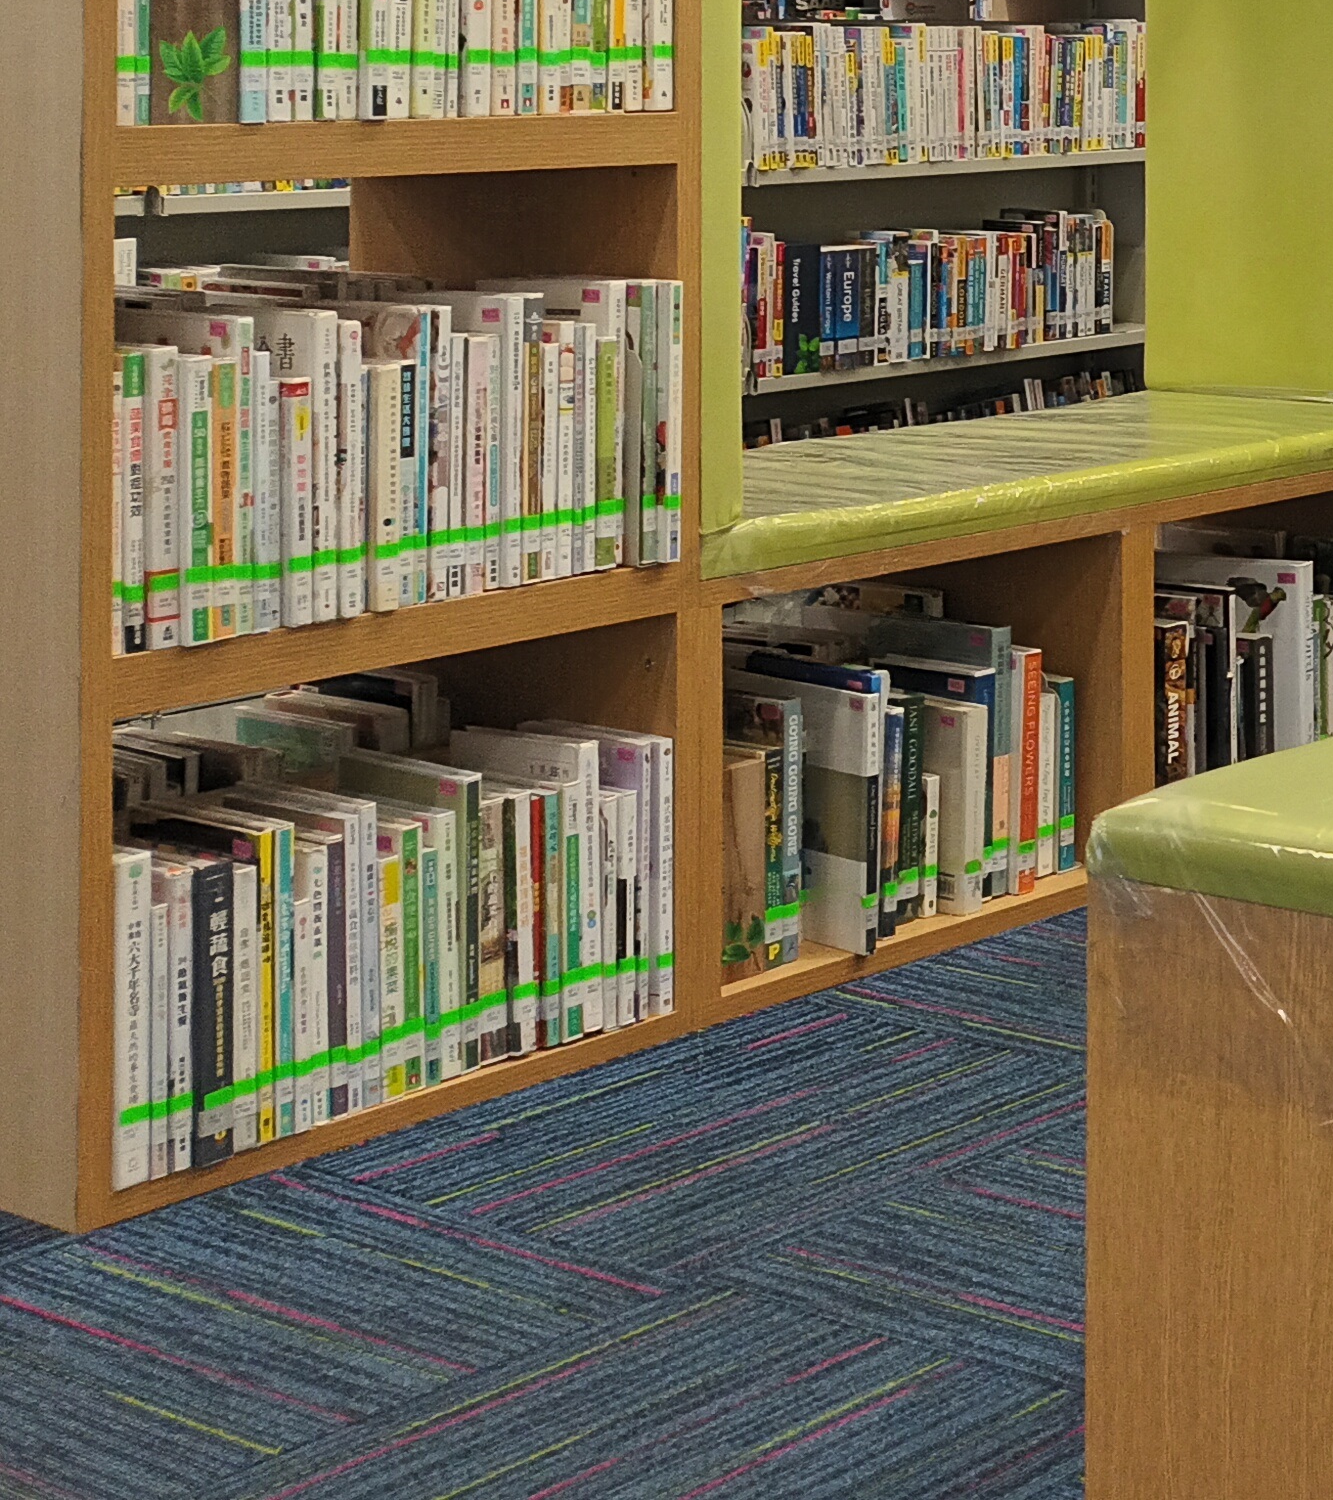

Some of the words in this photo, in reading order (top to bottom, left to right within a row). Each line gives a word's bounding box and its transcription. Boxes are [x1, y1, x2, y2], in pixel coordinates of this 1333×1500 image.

[791, 257, 803, 288] Travel
[824, 271, 833, 305] Western
[841, 271, 856, 322] Europe
[790, 288, 802, 324] Guides
[823, 306, 833, 335] Europe
[957, 281, 967, 328] LONDON
[1026, 660, 1040, 718] SEEING
[787, 713, 800, 763] GOING
[907, 705, 918, 736] JANE
[1166, 691, 1180, 764] ANIMAL
[906, 737, 918, 801] GOODALL
[1024, 719, 1038, 797] FLOWERS
[786, 764, 799, 813] GOING
[785, 813, 798, 858] GONE
